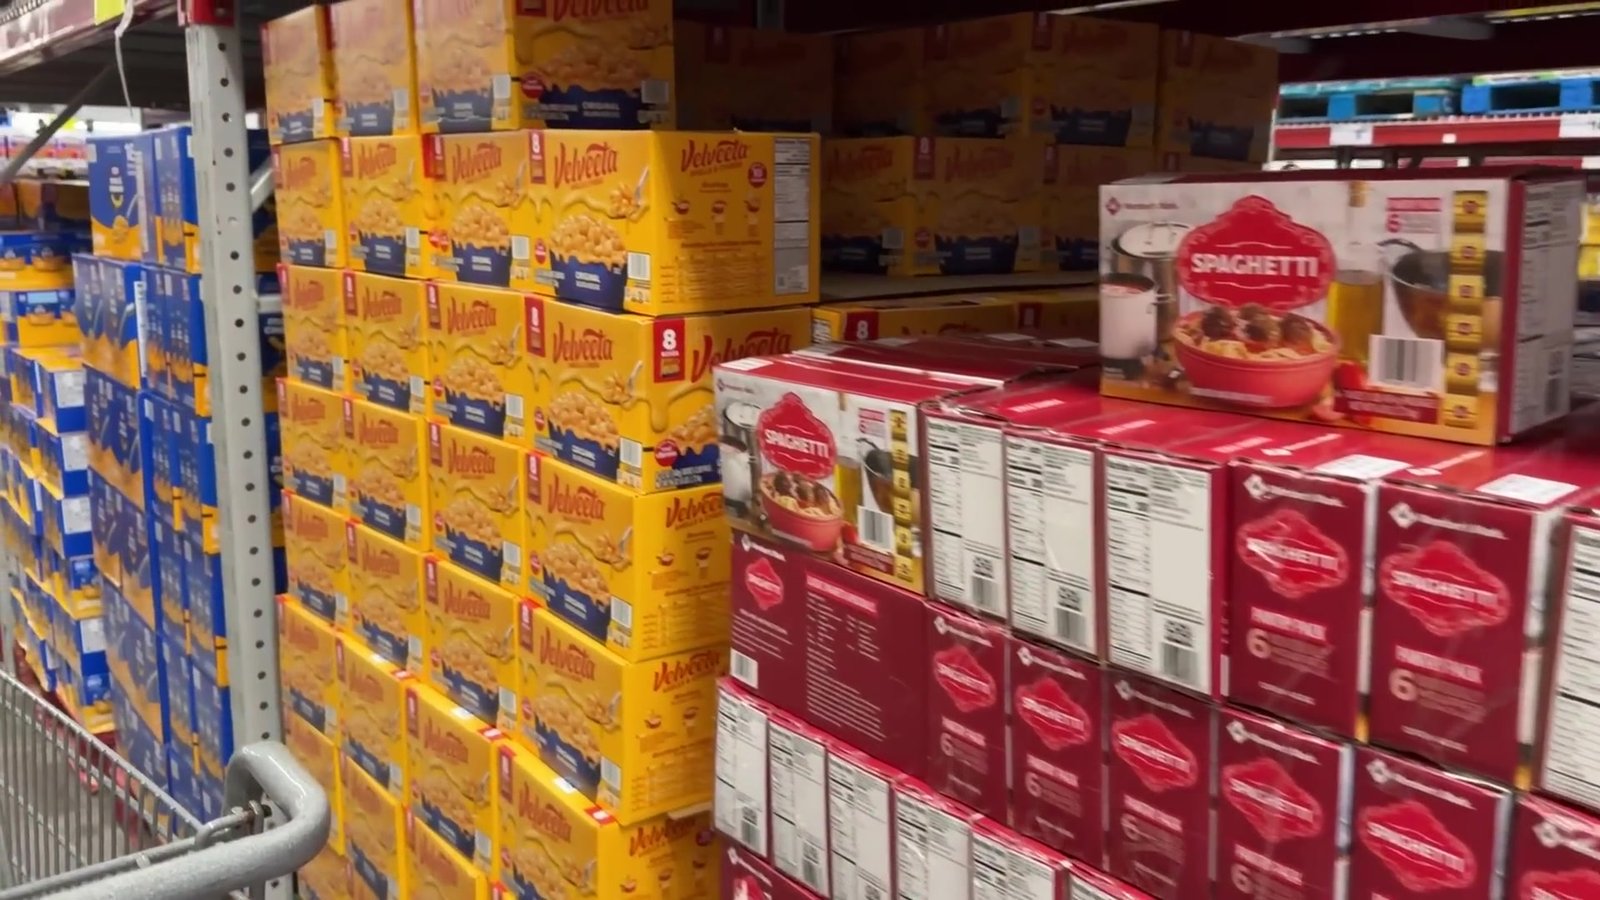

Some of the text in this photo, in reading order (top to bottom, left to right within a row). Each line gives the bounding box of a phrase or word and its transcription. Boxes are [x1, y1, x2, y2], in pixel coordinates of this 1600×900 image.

[554, 142, 618, 189] Velveeta
[681, 140, 750, 173] Velveeta
[1191, 252, 1319, 278] SPAGHETTI
[552, 321, 615, 365] Velveeta
[662, 328, 677, 351] 8
[856, 319, 869, 340] 8
[764, 428, 830, 459] SPAGHETTI
[547, 474, 606, 521] Velveeta
[539, 627, 596, 683] Velveeta
[1246, 628, 1271, 659] 6
[1389, 668, 1418, 702] 6
[518, 781, 572, 844] Velveeta
